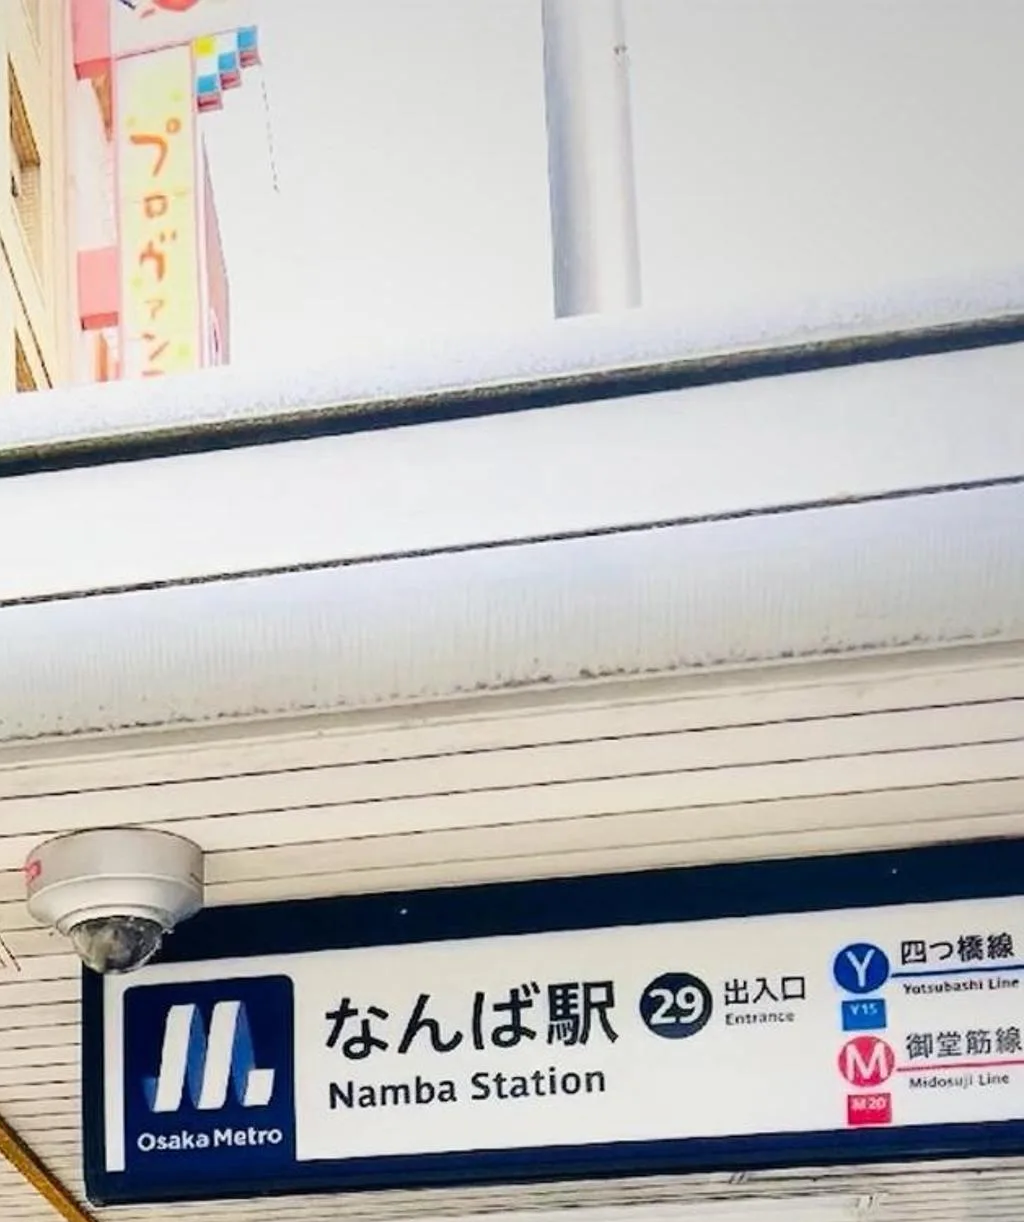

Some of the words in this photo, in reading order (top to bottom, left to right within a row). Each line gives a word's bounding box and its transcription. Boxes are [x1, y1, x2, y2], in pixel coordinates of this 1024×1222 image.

[130, 118, 182, 376] プロヴァン
[901, 932, 1015, 965] 四つ橋線
[724, 975, 807, 1006] 出入口
[989, 976, 1020, 990] Line
[324, 979, 620, 1060] なんば駅
[648, 986, 704, 1026] 29
[724, 1009, 795, 1027] Entrance
[906, 1026, 1024, 1060] 御堂筋線
[845, 1041, 889, 1082] M
[328, 1079, 458, 1109] Namba
[470, 1065, 607, 1100] Station
[908, 1074, 973, 1090] Midosuji
[978, 1073, 1010, 1087] Line
[137, 1132, 210, 1152] Osaka
[213, 1126, 283, 1148] Metro
